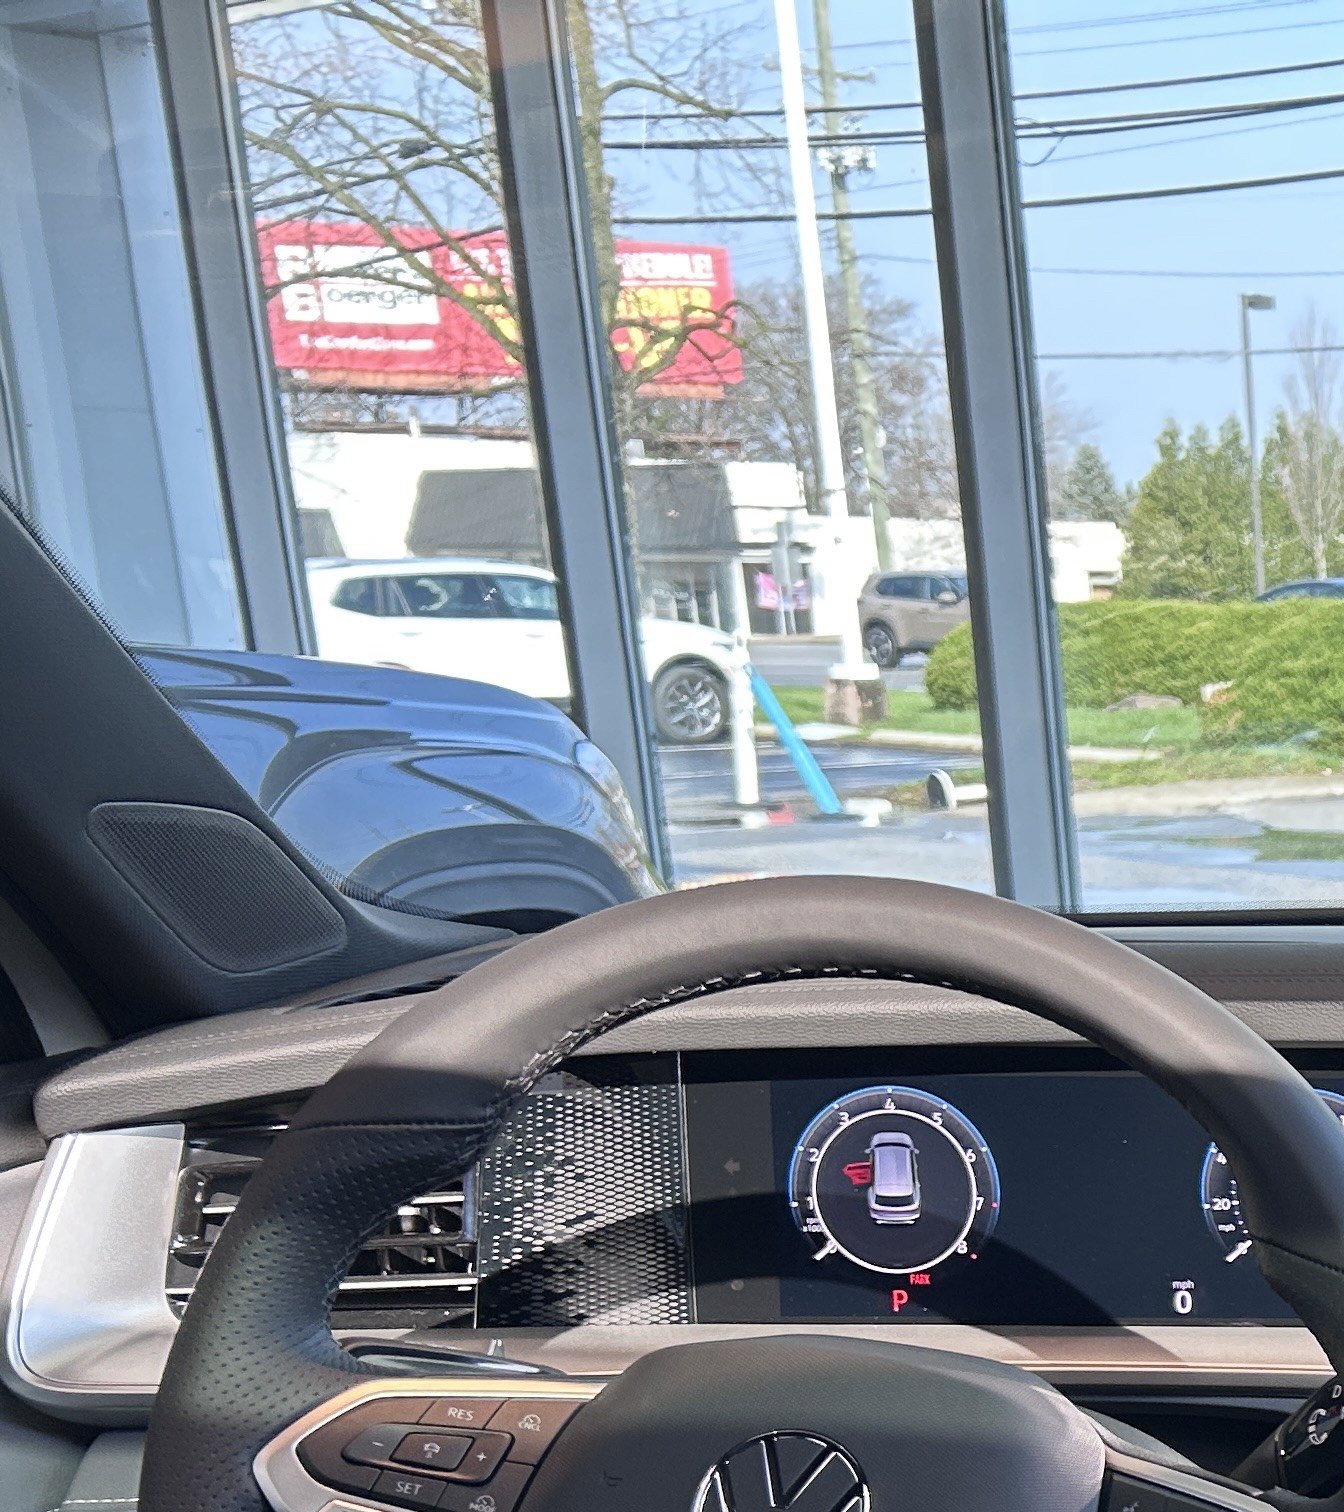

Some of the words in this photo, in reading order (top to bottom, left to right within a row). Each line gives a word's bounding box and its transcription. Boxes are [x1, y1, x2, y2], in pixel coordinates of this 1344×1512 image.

[885, 1098, 896, 1111] 4
[838, 1112, 850, 1126] 3
[932, 1112, 943, 1126] 5
[808, 1148, 819, 1162] 2
[966, 1150, 977, 1163] 6
[805, 1196, 814, 1210] 1
[976, 1196, 985, 1211] 7
[1211, 1198, 1231, 1211] 20
[957, 1240, 968, 1254] 8
[1172, 1279, 1195, 1290] mph
[892, 1289, 909, 1312] P
[1173, 1290, 1193, 1314] 0
[1332, 1384, 1342, 1398] D
[447, 1406, 475, 1421] RES
[395, 1481, 422, 1495] SET
